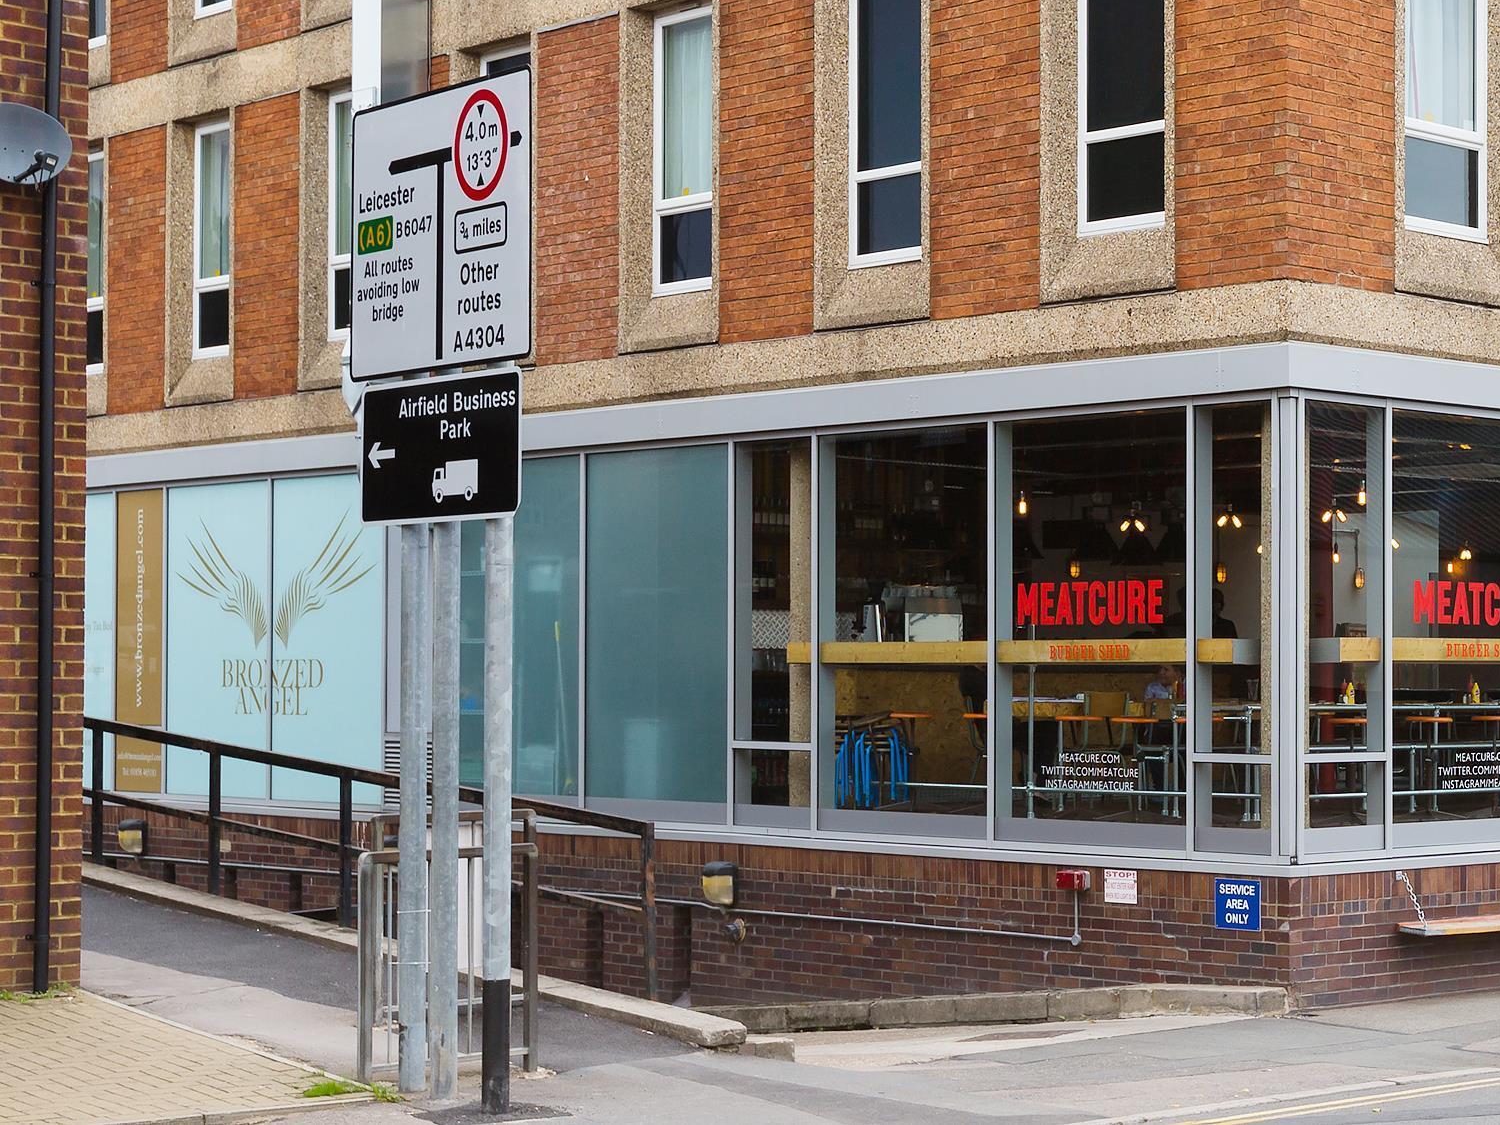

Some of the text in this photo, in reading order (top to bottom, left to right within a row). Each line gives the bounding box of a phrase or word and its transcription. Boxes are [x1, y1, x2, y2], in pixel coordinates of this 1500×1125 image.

[359, 185, 415, 214] Leicester
[358, 215, 433, 250] (A6) B6047
[472, 217, 502, 237] miles
[364, 255, 414, 279] All routes
[460, 262, 499, 286] Other
[357, 276, 421, 303] avoiding low
[372, 302, 405, 323] bridge
[457, 291, 502, 316] routes
[453, 323, 506, 353] A4304
[398, 389, 517, 419] Airfield Business
[440, 417, 472, 441] Park
[134, 508, 145, 709] www.bronzedangel.com
[1017, 579, 1164, 626] MEATCURE
[1049, 643, 1130, 661] BURGER SHED
[1446, 642, 1490, 658] BURGER
[222, 657, 324, 690] BRONZED
[234, 686, 309, 717] ANGEL
[1058, 752, 1121, 764] MEATCURE.COM
[1040, 765, 1139, 779] TWITTER.COM/MEATCURE
[1045, 778, 1135, 791] INSTAGRAM/MEATCURE
[1105, 870, 1136, 879] STOP!
[1219, 883, 1256, 896] SERVICE
[1225, 898, 1250, 911] AREA
[1225, 912, 1250, 925] ONLY
